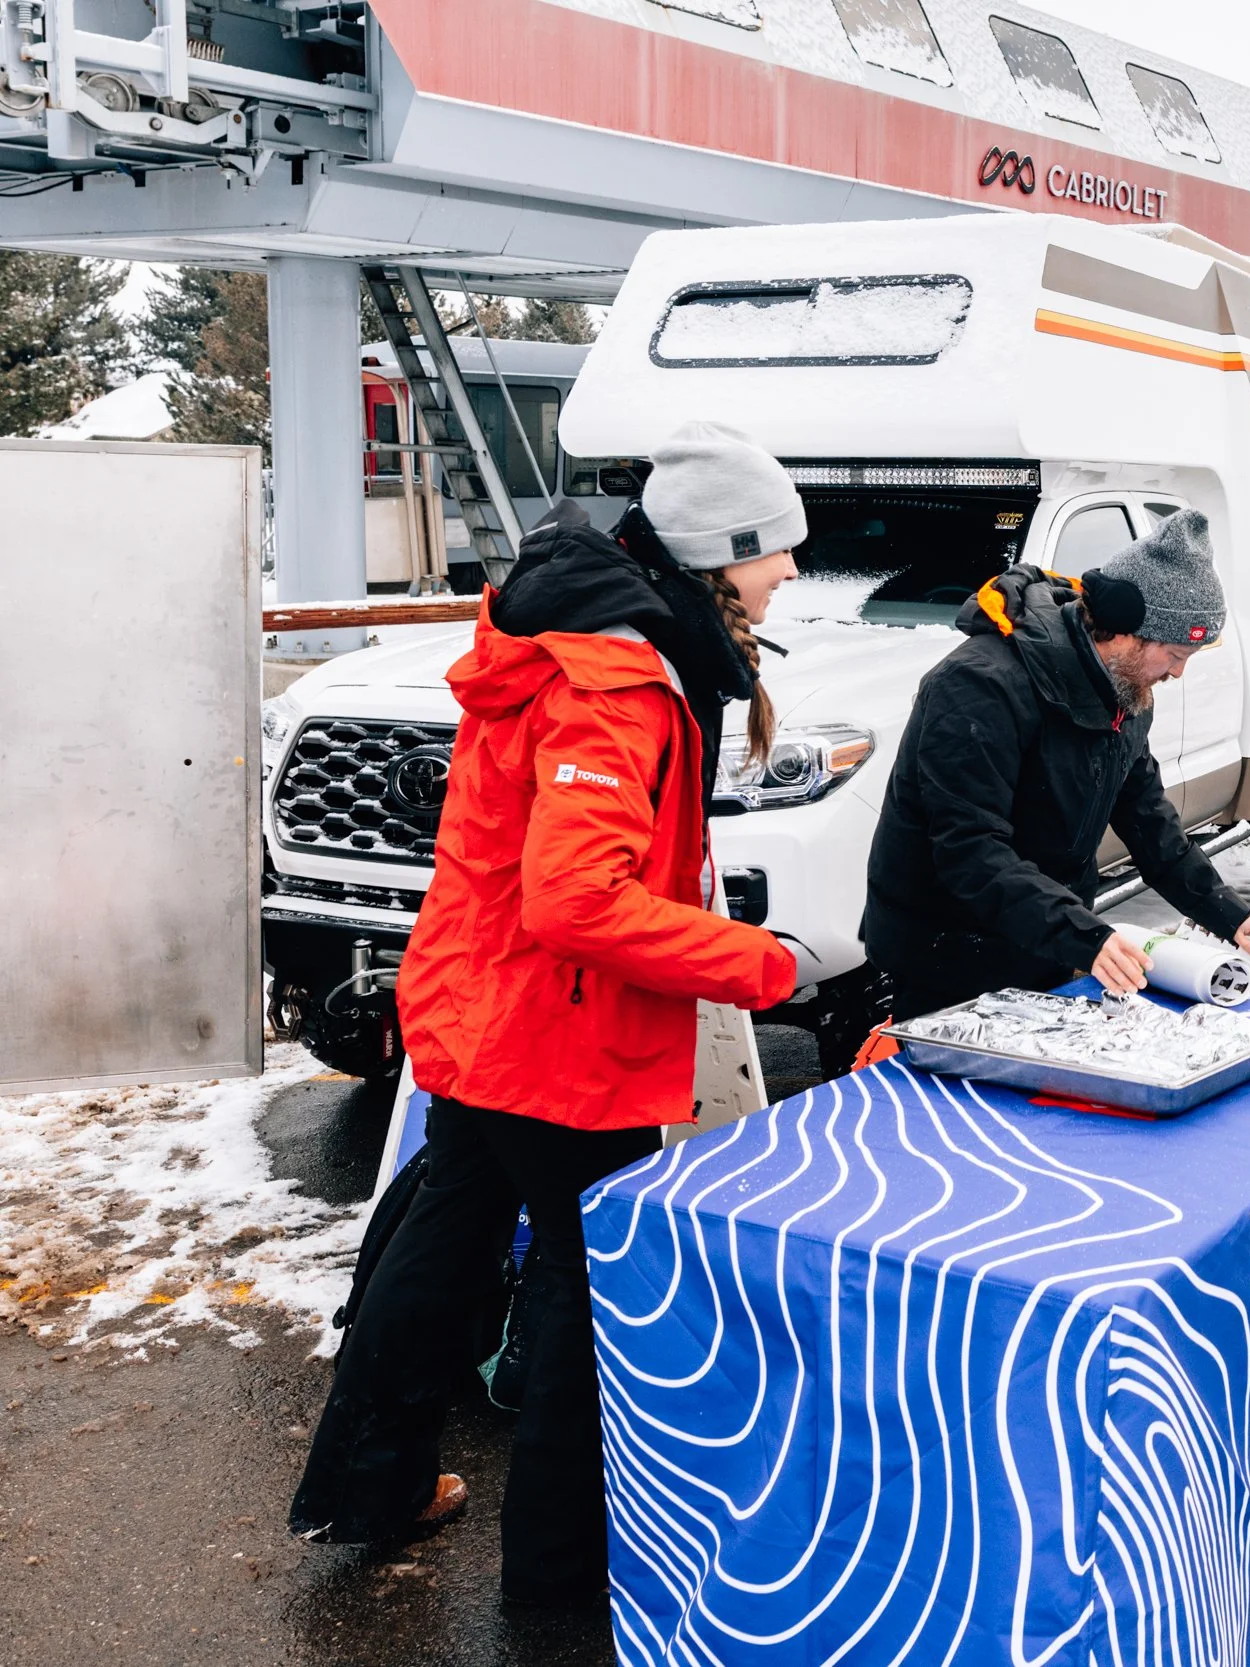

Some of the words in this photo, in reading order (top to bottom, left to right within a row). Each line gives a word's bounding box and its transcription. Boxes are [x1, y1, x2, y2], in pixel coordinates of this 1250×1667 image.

[1047, 164, 1168, 219] CABRIOLET
[576, 769, 620, 788] TOYOTA
[385, 1029, 393, 1058] WARN
